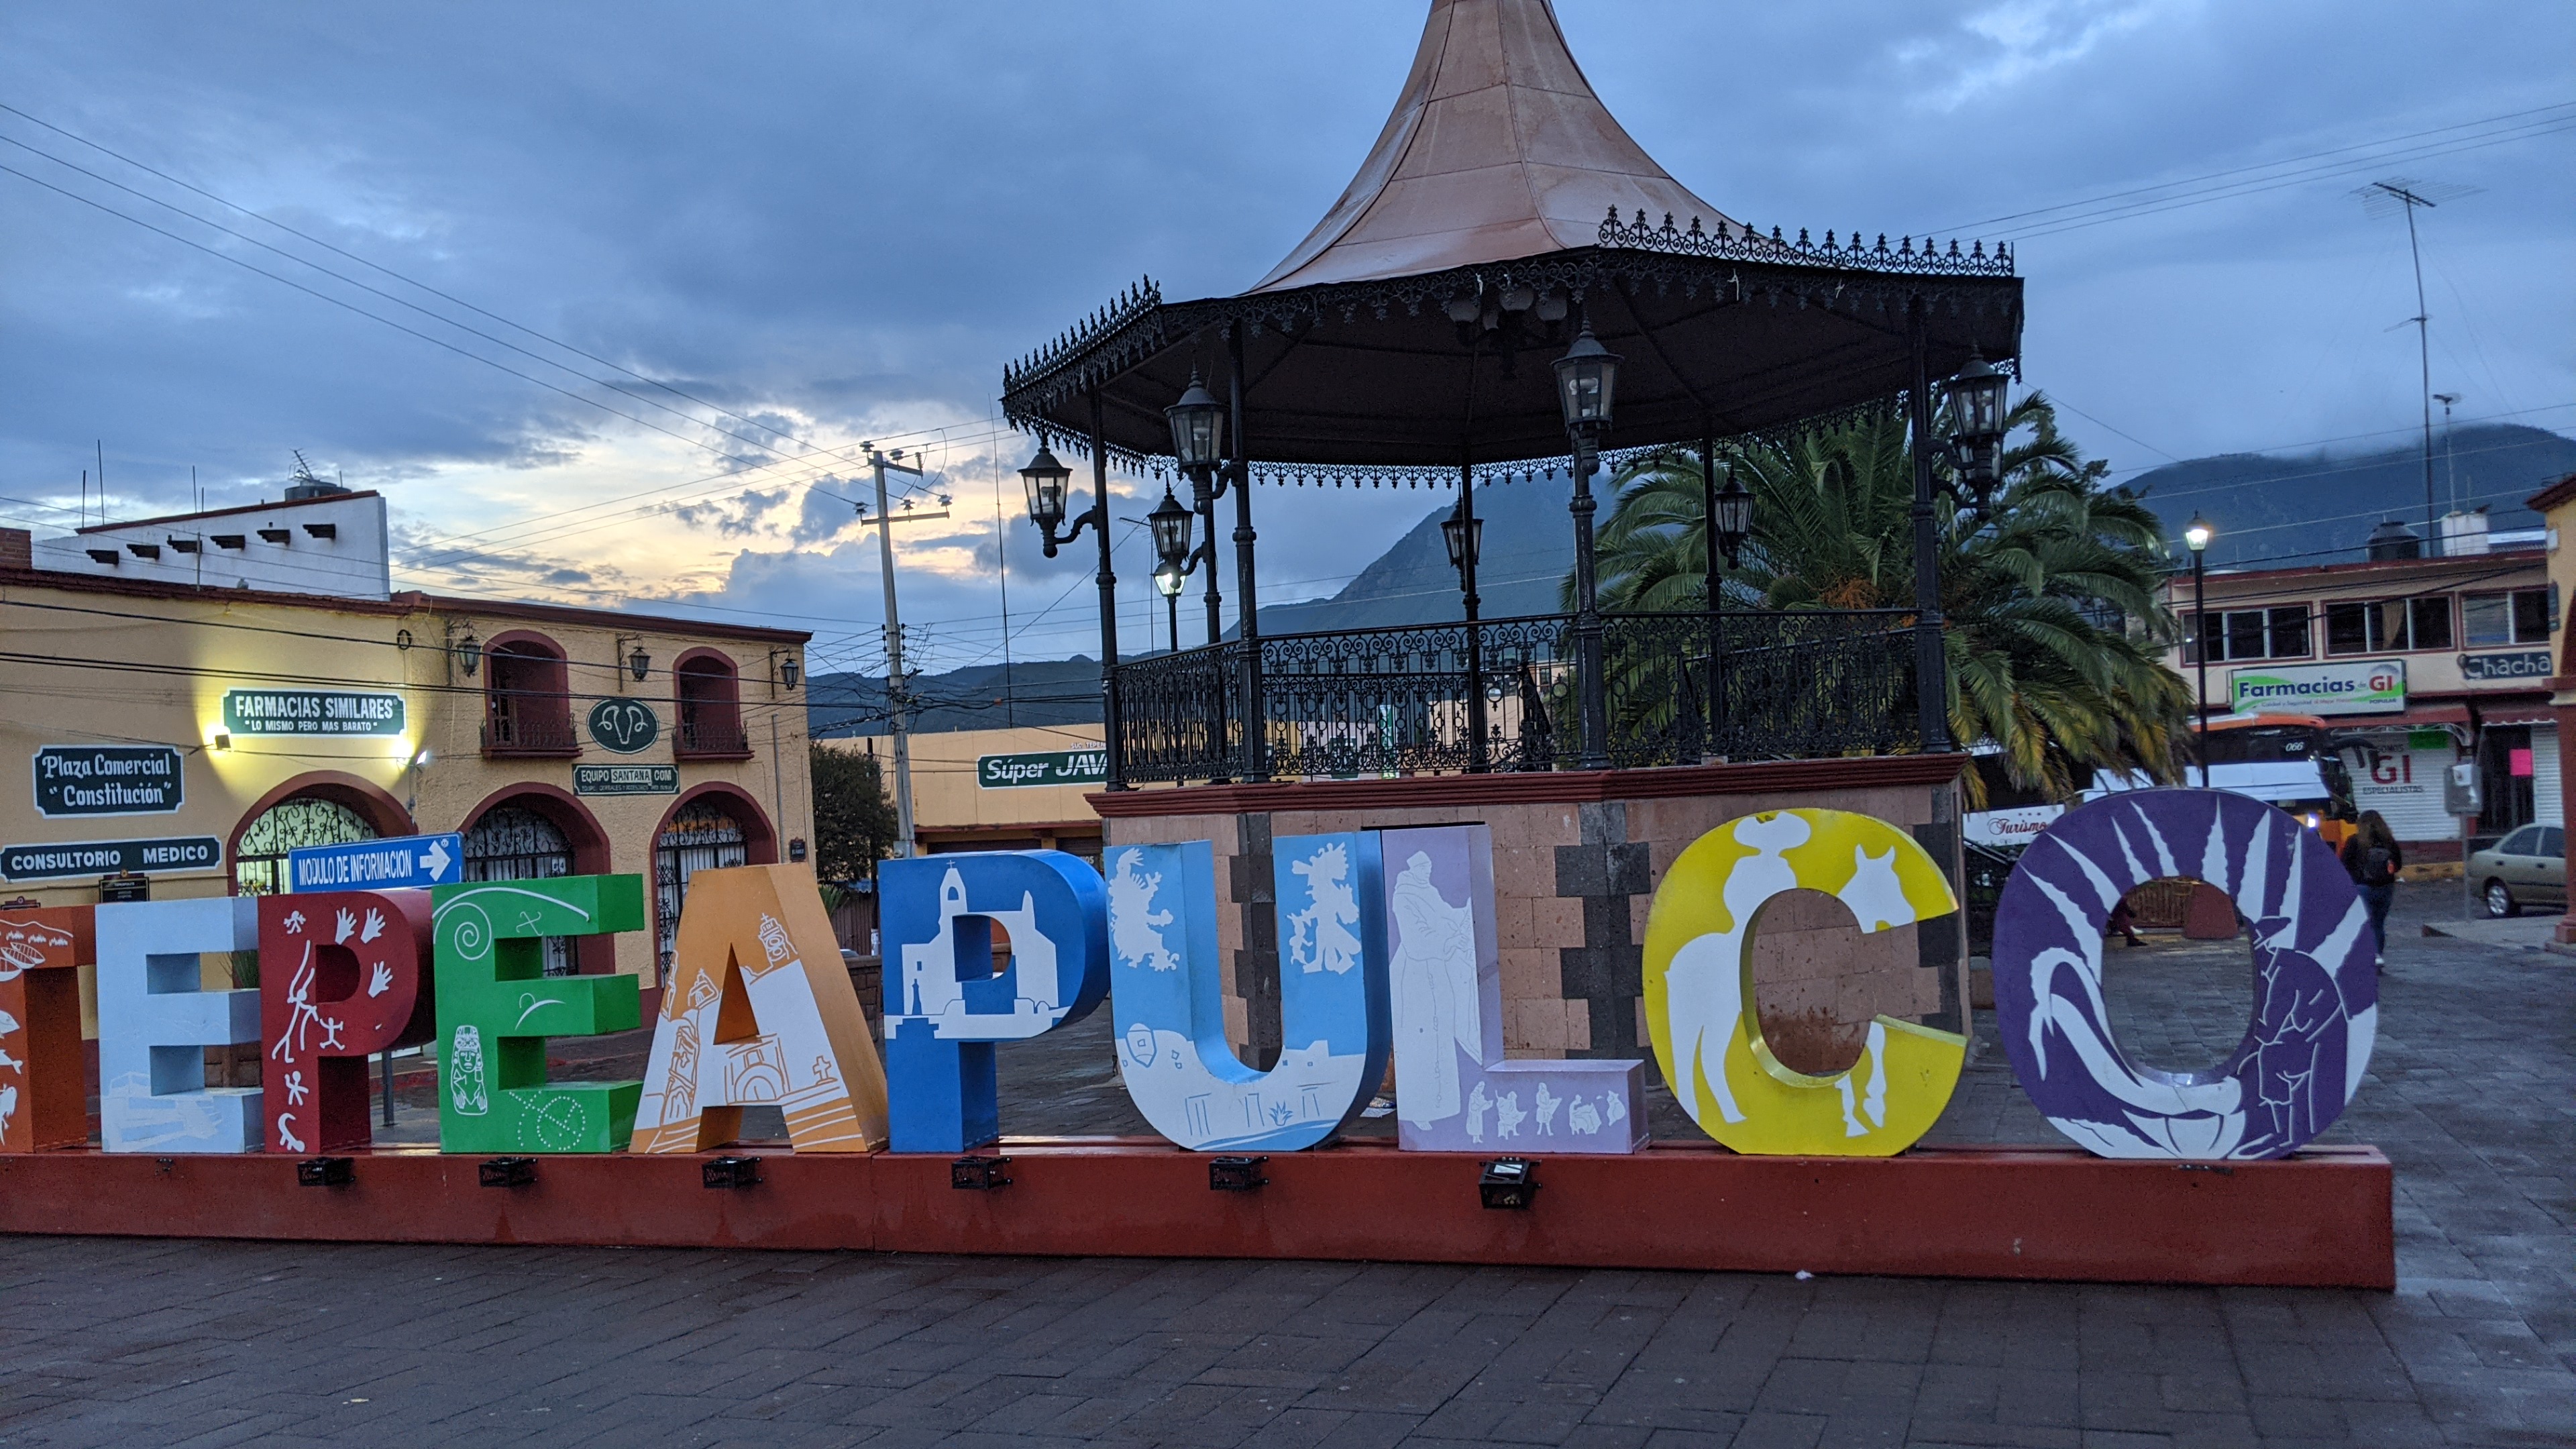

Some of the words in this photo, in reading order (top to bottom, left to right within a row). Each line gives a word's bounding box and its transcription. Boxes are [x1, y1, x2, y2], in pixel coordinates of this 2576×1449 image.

[2239, 676, 2355, 698] Farmacias
[2369, 675, 2394, 692] GI
[235, 696, 321, 718] FARMACIAS
[325, 698, 394, 720] SIMILARES
[266, 720, 294, 731] MISMO
[298, 720, 318, 731] PERO
[322, 720, 339, 732] MAS
[2285, 742, 2304, 752] 066
[42, 755, 93, 779] Plaza
[95, 753, 171, 775] Comercial
[581, 769, 609, 784] EQUIPO
[612, 770, 651, 782] SANTANA
[654, 769, 672, 782] COM
[986, 758, 1049, 784] Súper
[1055, 753, 1108, 777] JAV
[1987, 817, 2049, 835] Turismo
[11, 850, 121, 871] CONSULTORIO
[143, 845, 209, 864] MEDICO
[299, 857, 335, 886] MODULO
[337, 855, 350, 884] DE
[350, 849, 413, 883] INFORMACION
